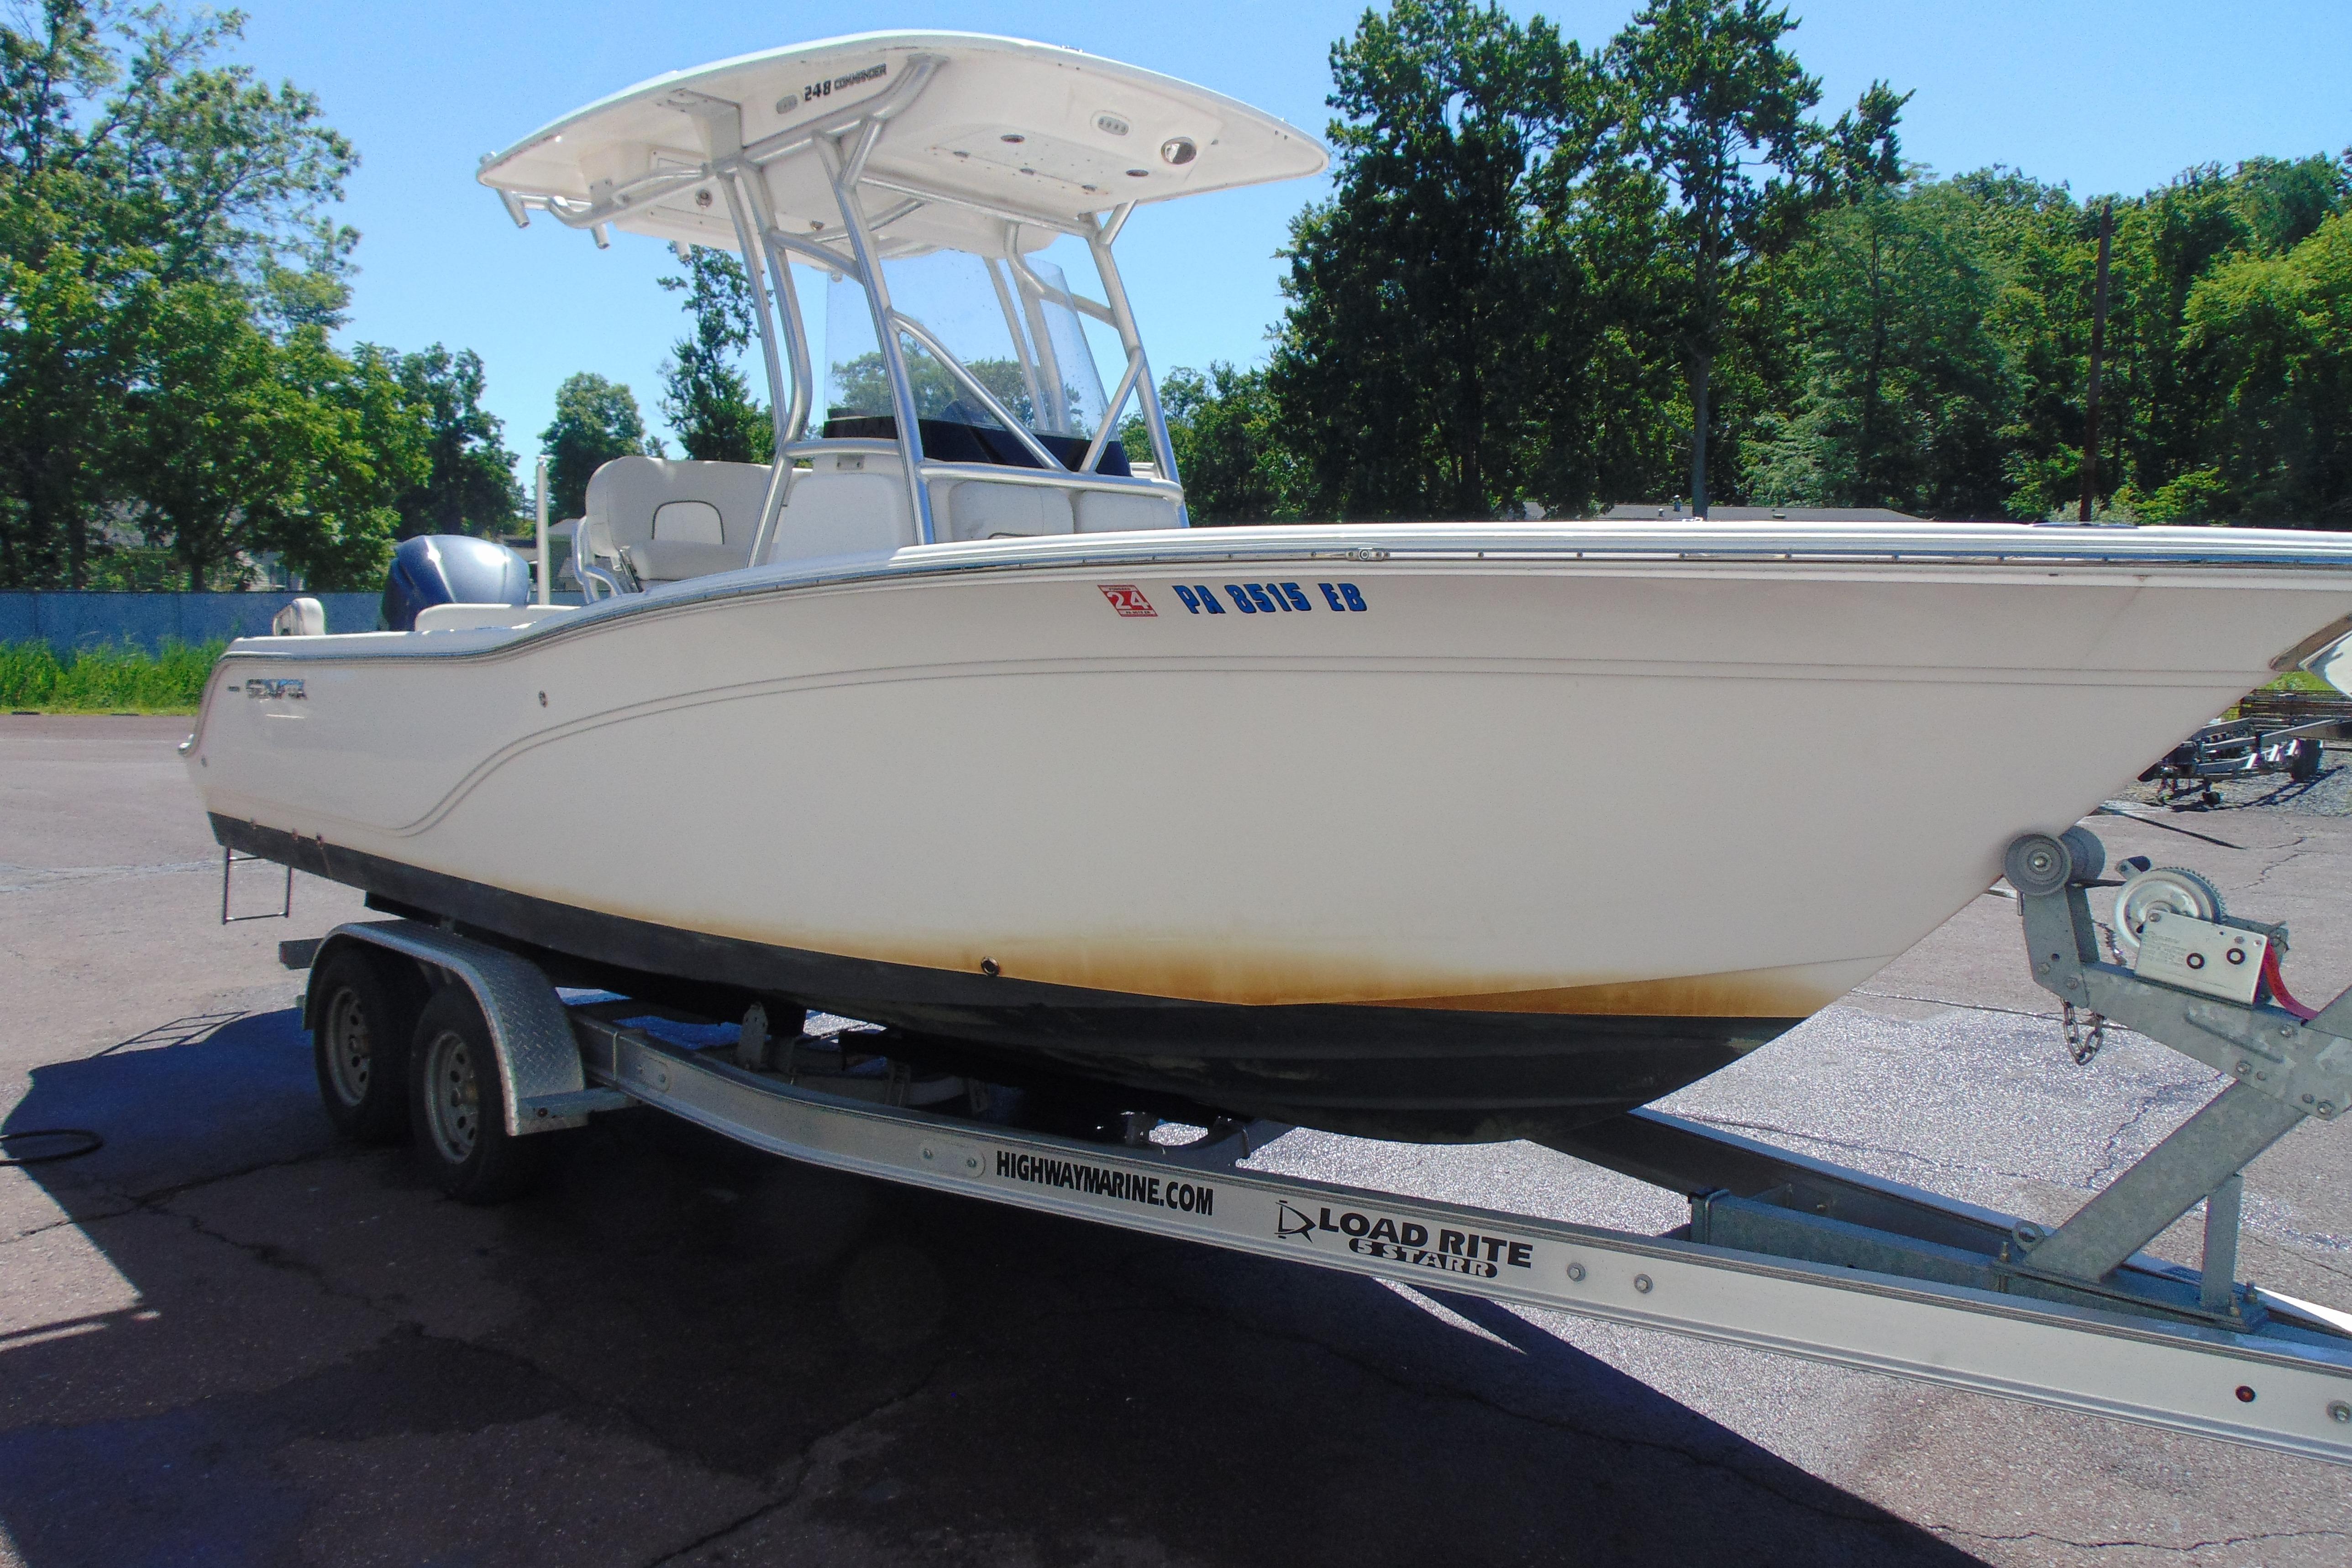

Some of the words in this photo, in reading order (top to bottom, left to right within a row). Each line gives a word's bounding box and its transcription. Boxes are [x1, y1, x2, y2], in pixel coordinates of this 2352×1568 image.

[804, 80, 831, 101] 248
[1107, 591, 1150, 609] 24
[1171, 585, 1226, 614] PA
[1224, 583, 1312, 614] 8515
[1318, 583, 1368, 612] EB
[996, 1150, 1214, 1216] HIGHWAYMARINE.COM
[1319, 1207, 1428, 1248] LOAD
[1438, 1228, 1533, 1269] RITE
[1357, 1238, 1373, 1254] 5
[1382, 1244, 1489, 1277] STARR
